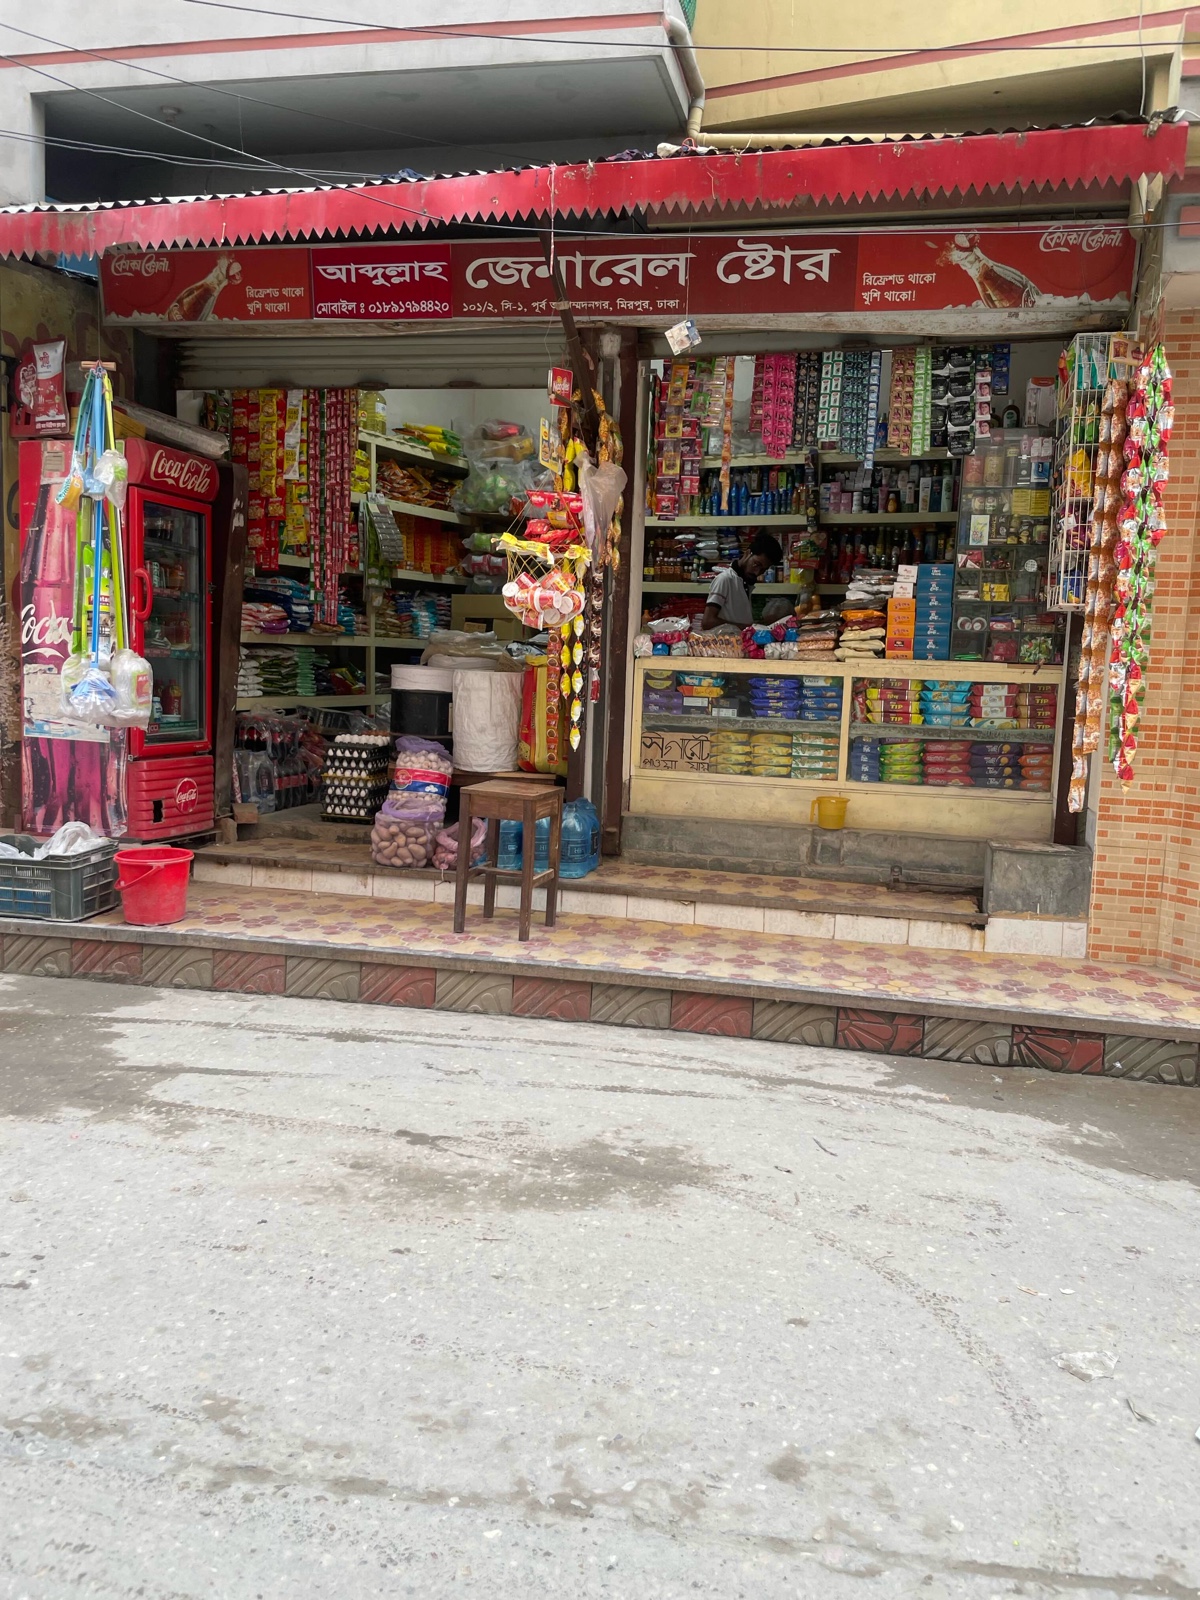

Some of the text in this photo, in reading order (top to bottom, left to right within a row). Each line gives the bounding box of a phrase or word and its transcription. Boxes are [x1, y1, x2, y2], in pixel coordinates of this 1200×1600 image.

[465, 238, 841, 289] জেনারেল ষ্টোর
[315, 261, 448, 287] আব্দুল্লাহ
[862, 272, 936, 286] রিফ্রেশড থাকো
[246, 286, 304, 298] রিফ্রেশড থাকো
[861, 288, 916, 305] খুশি থাকো!
[246, 301, 290, 315] খুশি থাকো!
[316, 298, 357, 314] মোবাইল
[368, 300, 449, 313] ০১৮৯১৭৯৪৪২০
[463, 301, 498, 313] ১০১/২,
[501, 299, 527, 312] সি-১,
[531, 298, 548, 313] পূর্ব
[616, 297, 653, 311] মিরপুর,
[641, 731, 710, 761] সিগারেট
